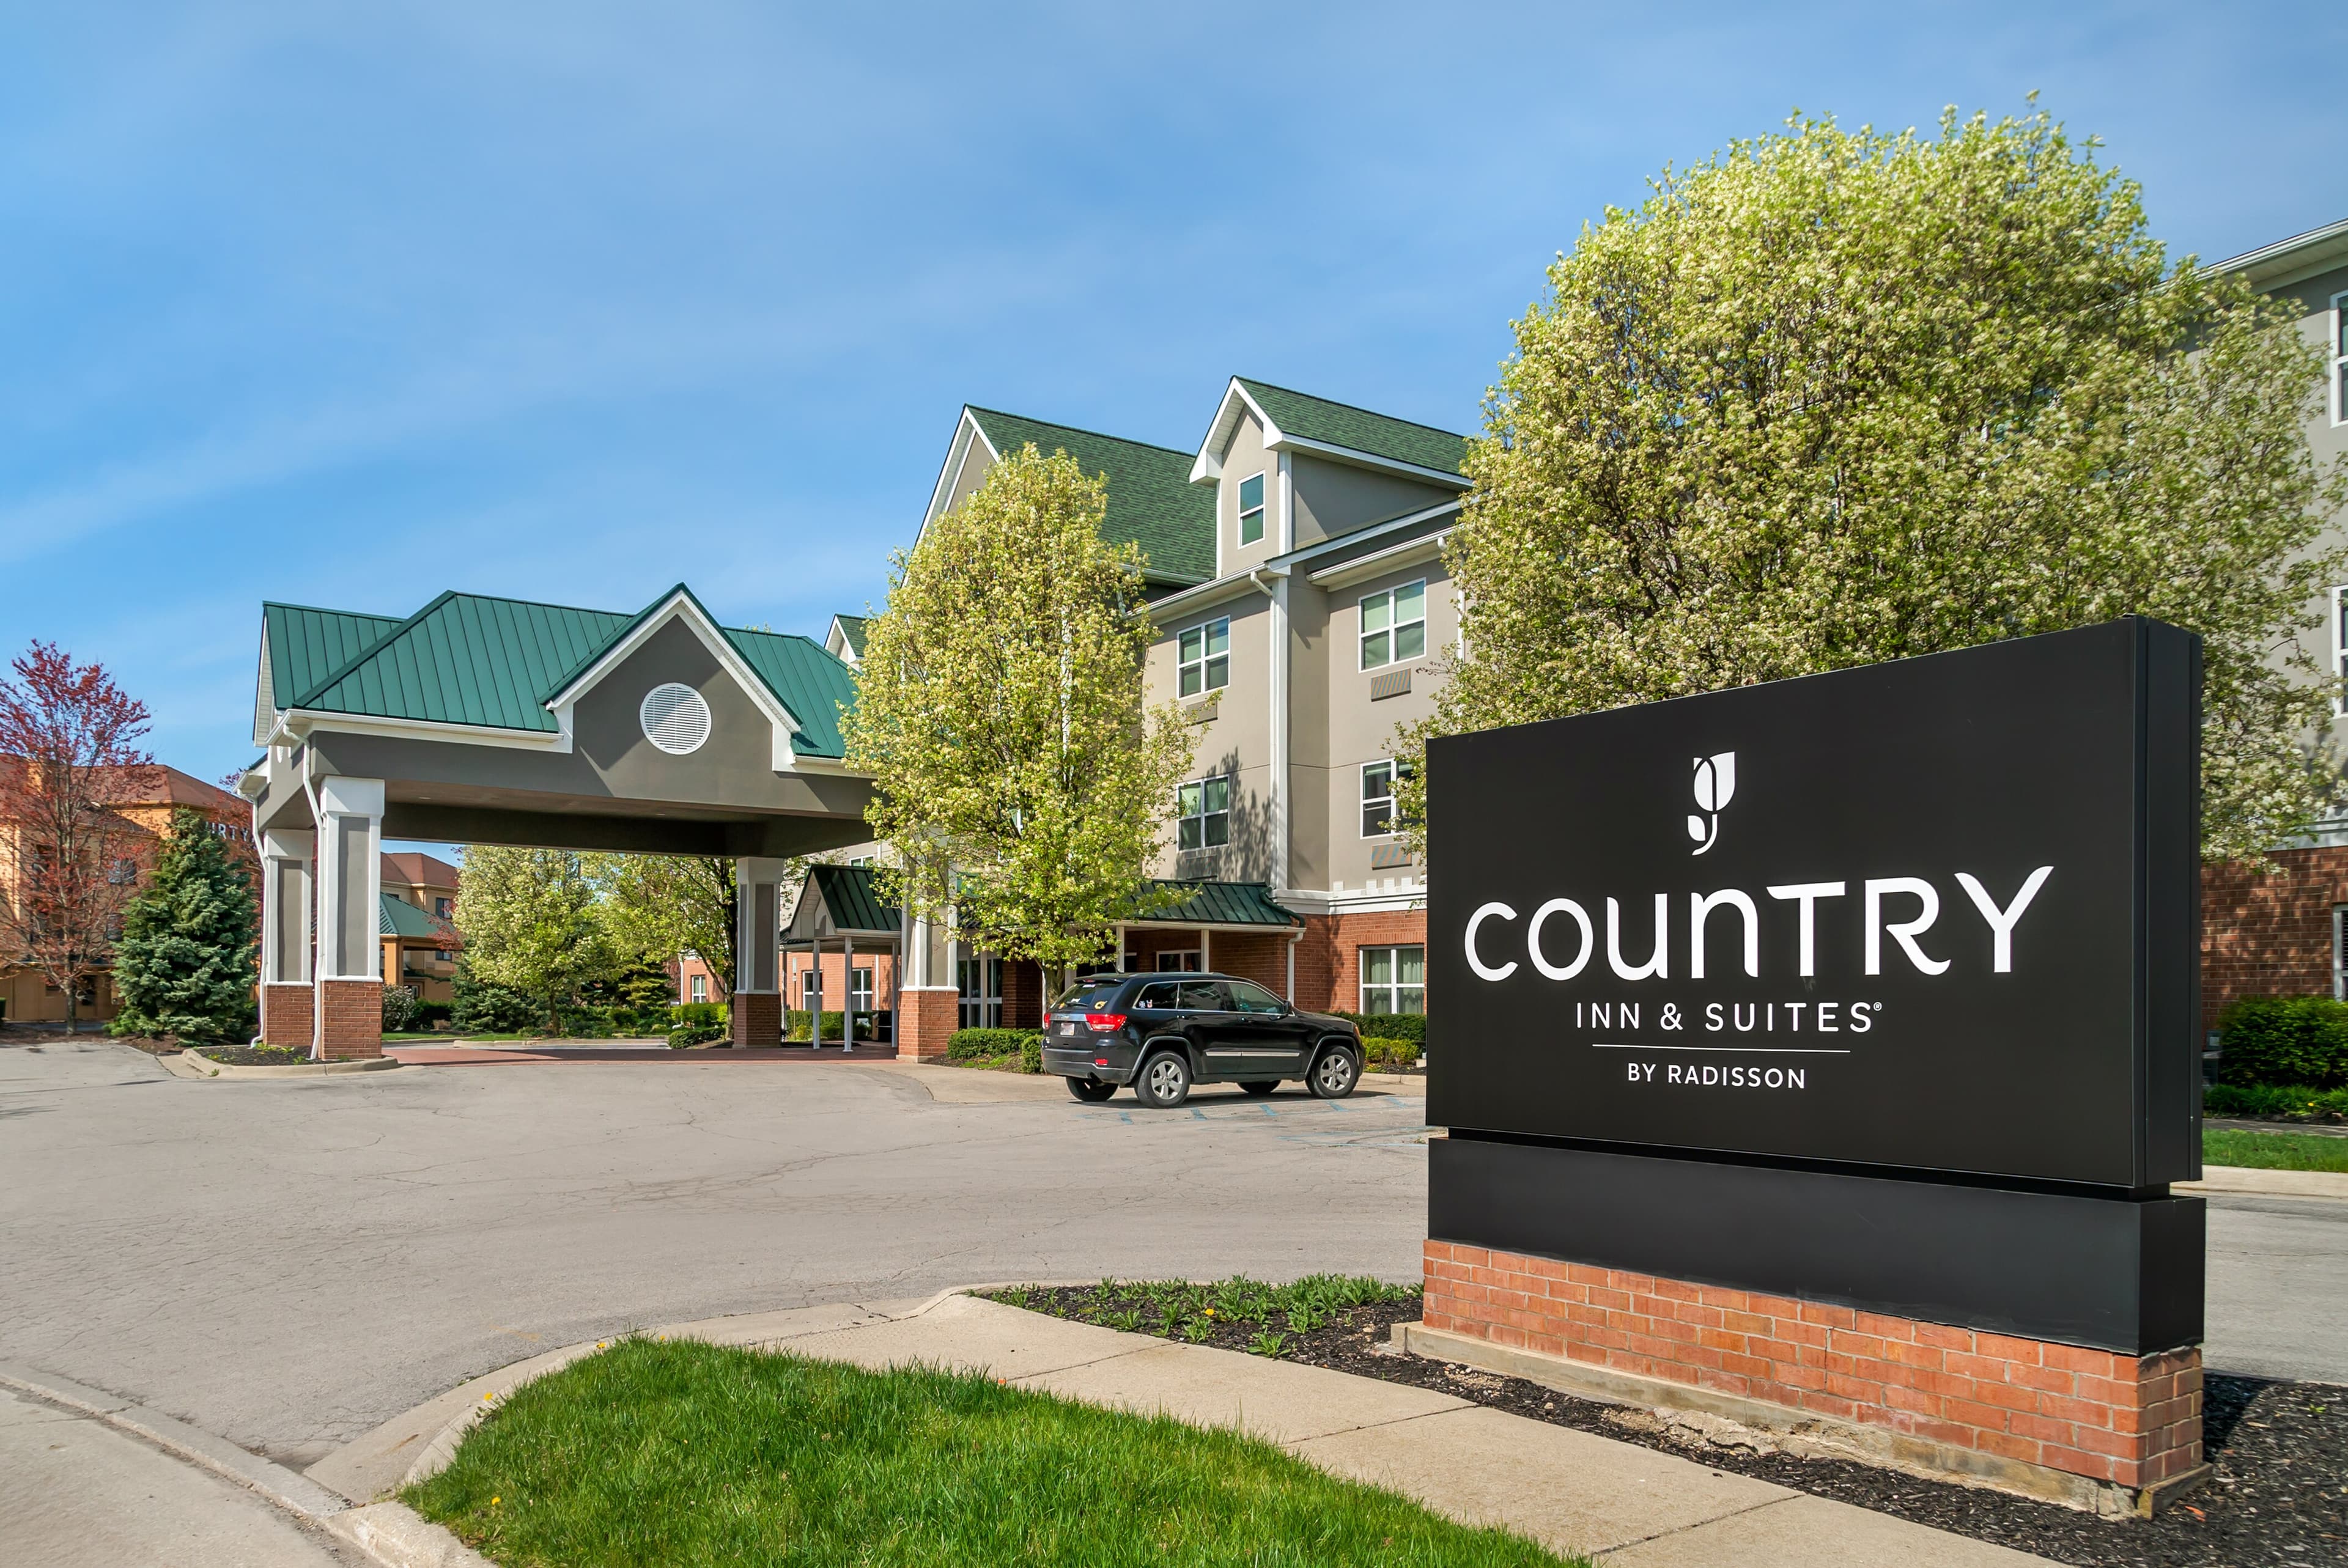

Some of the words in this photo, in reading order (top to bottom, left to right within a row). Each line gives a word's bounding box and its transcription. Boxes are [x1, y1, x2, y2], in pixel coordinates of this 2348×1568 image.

[1576, 1002, 1640, 1029] INN
[1660, 1003, 1683, 1031] &
[1627, 1062, 1657, 1083] BY
[1667, 1064, 1805, 1090] RADISSON
